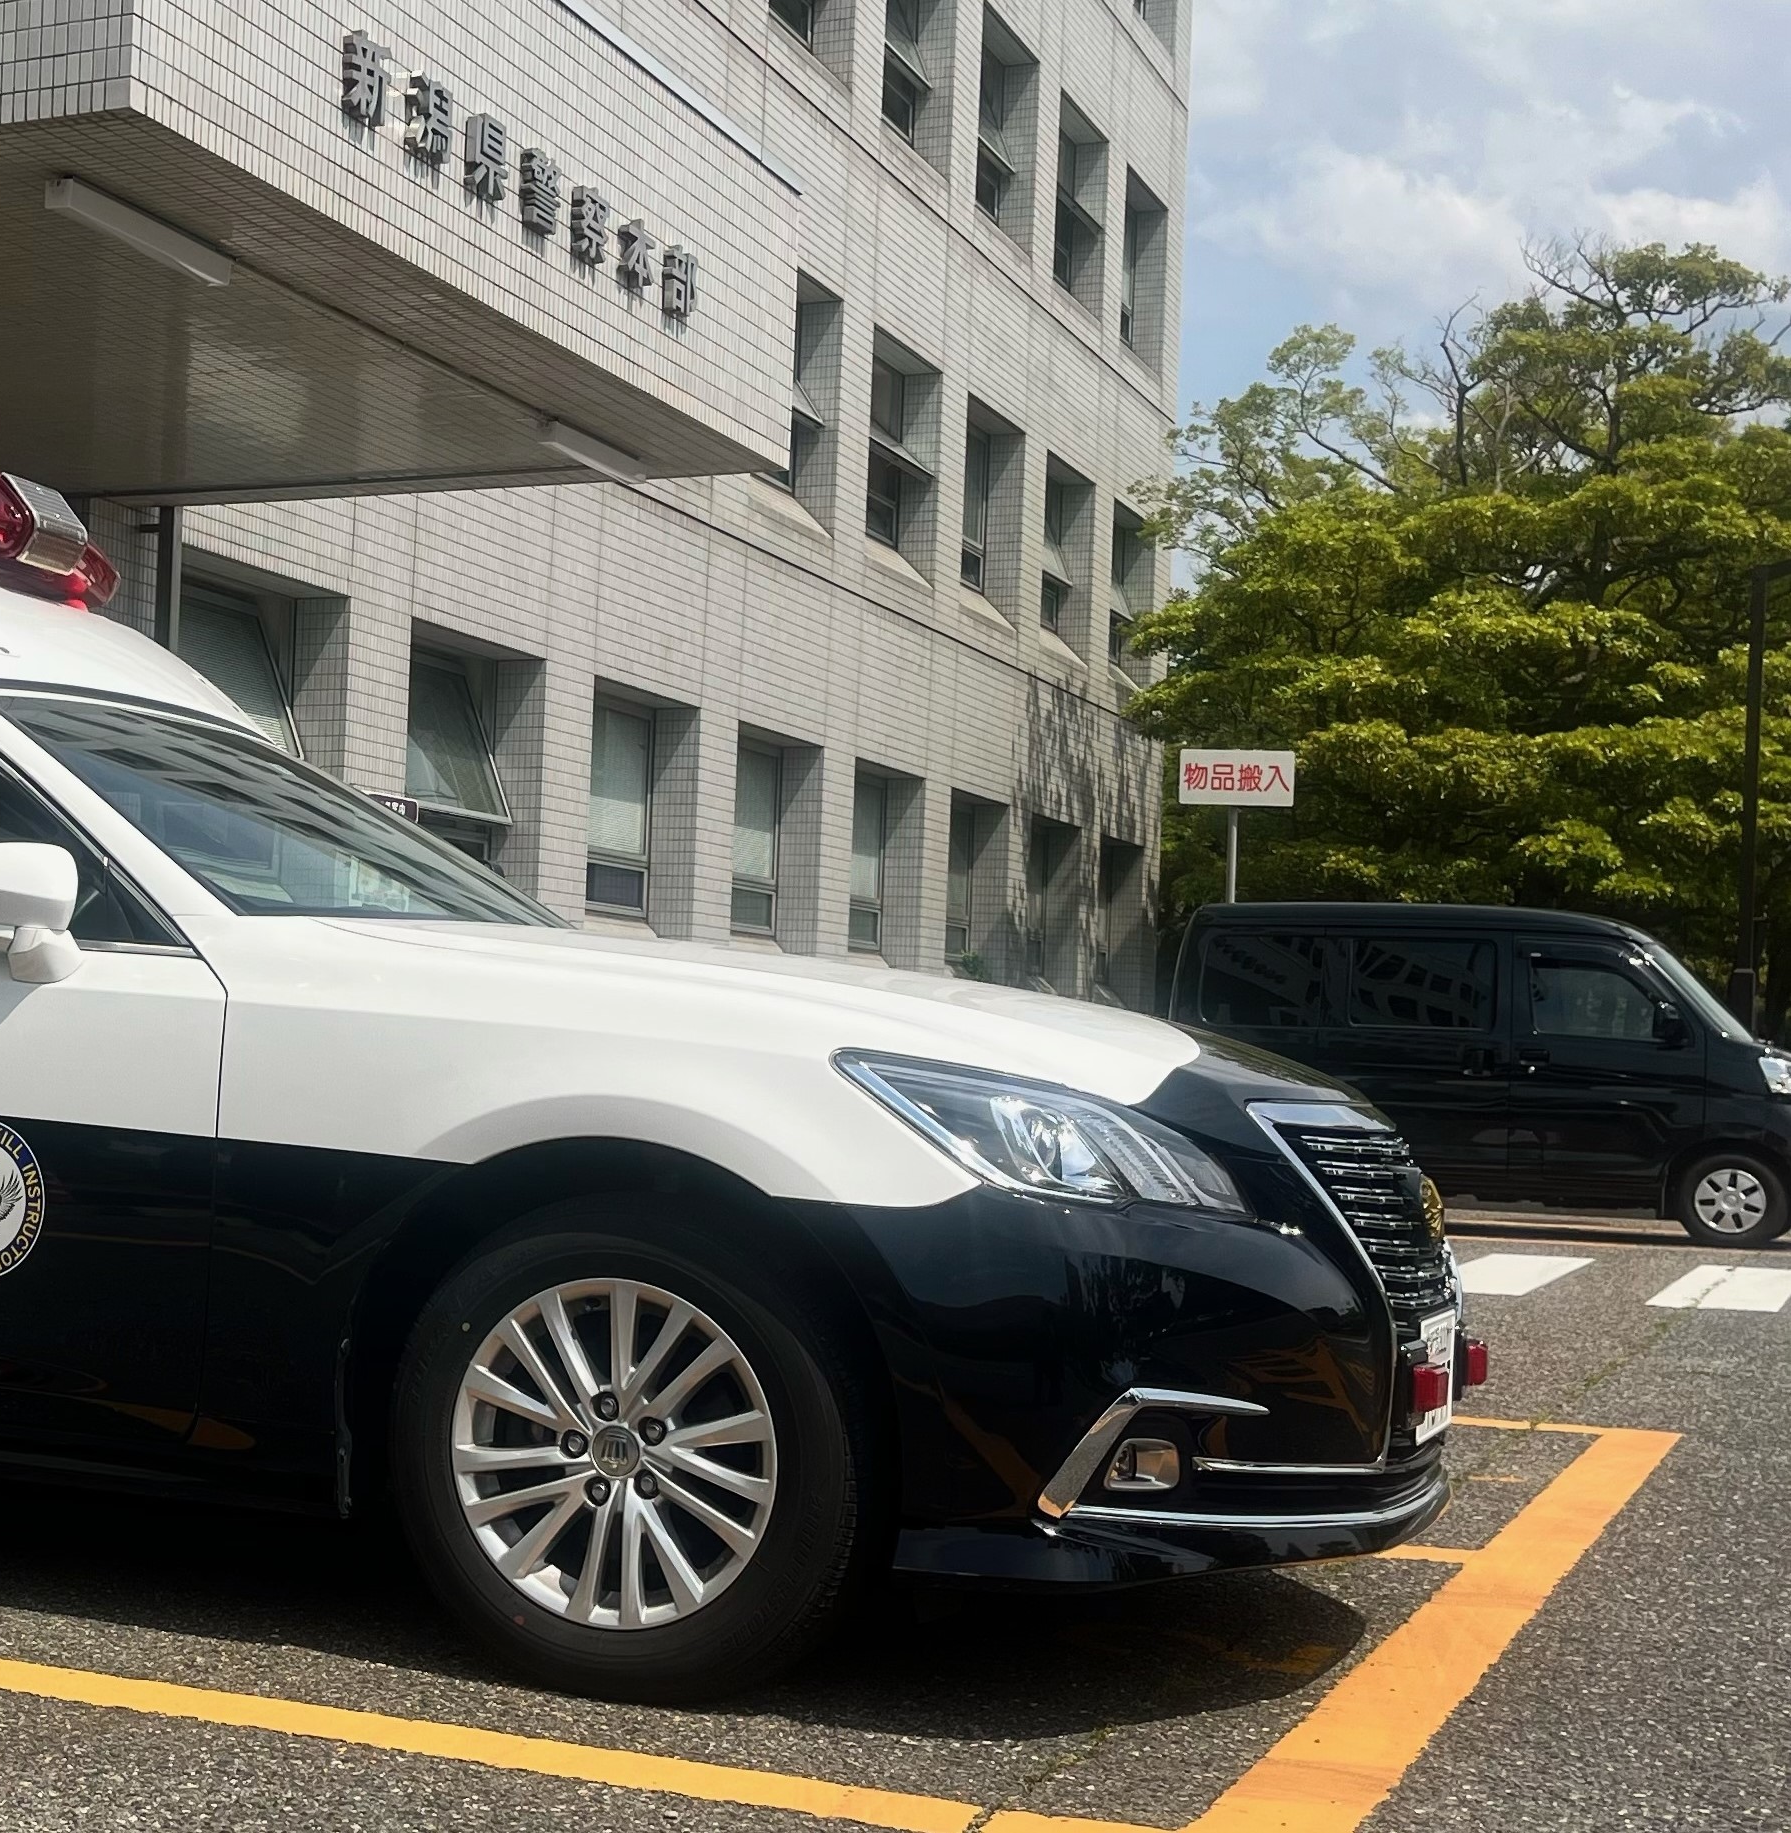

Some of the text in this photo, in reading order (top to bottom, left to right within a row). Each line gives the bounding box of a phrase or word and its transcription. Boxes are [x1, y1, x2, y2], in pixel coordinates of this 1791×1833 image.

[341, 28, 698, 319] 新潟県警察本部
[1183, 762, 1290, 792] 物品搬入
